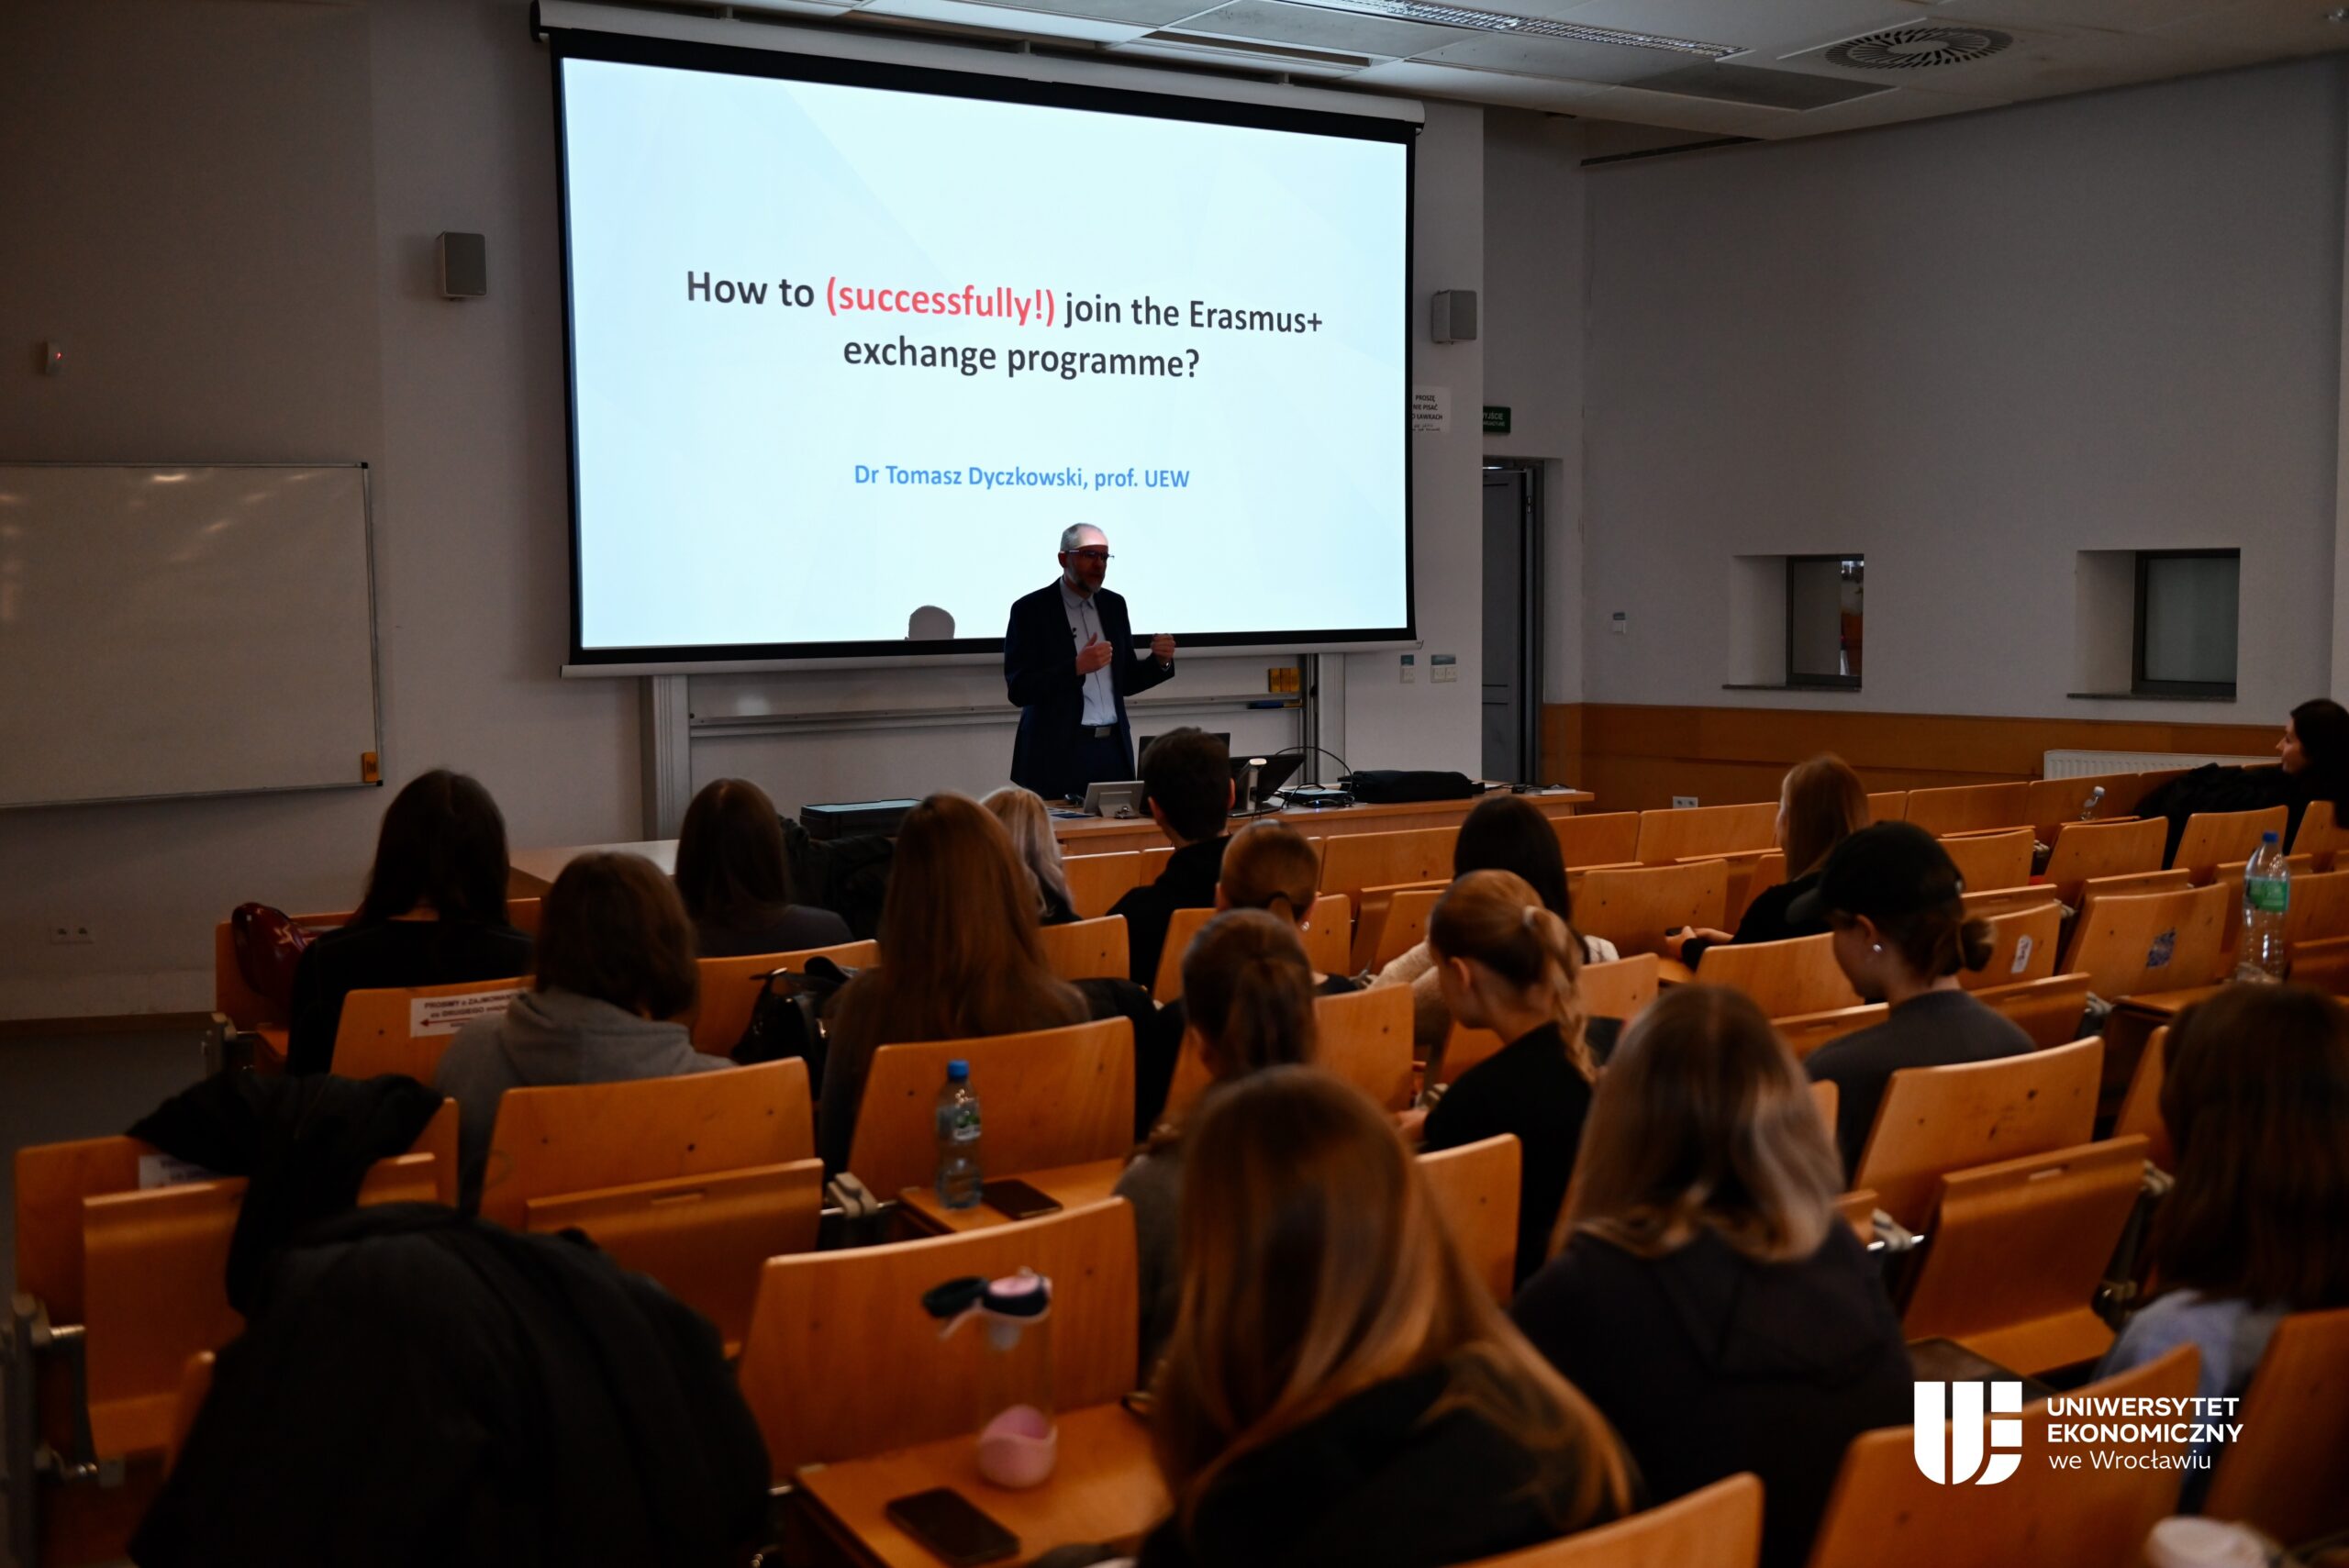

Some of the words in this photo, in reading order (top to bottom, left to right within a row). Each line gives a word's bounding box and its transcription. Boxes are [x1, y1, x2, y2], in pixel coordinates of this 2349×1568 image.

[687, 270, 768, 306] How
[778, 278, 815, 308] to
[827, 276, 1054, 328] (successfully!)
[1063, 292, 1121, 328] join
[1130, 295, 1180, 328] the
[1190, 300, 1323, 334] Erasmus+
[843, 334, 996, 377] exchange
[1008, 347, 1200, 381] programme?
[1483, 411, 1504, 420] YJŚCIE
[854, 464, 880, 484] Dr
[885, 465, 963, 485] Tomasz
[968, 466, 1088, 491] Dyczkowski,
[1095, 467, 1138, 492] prof.
[1144, 469, 1190, 488] UEW
